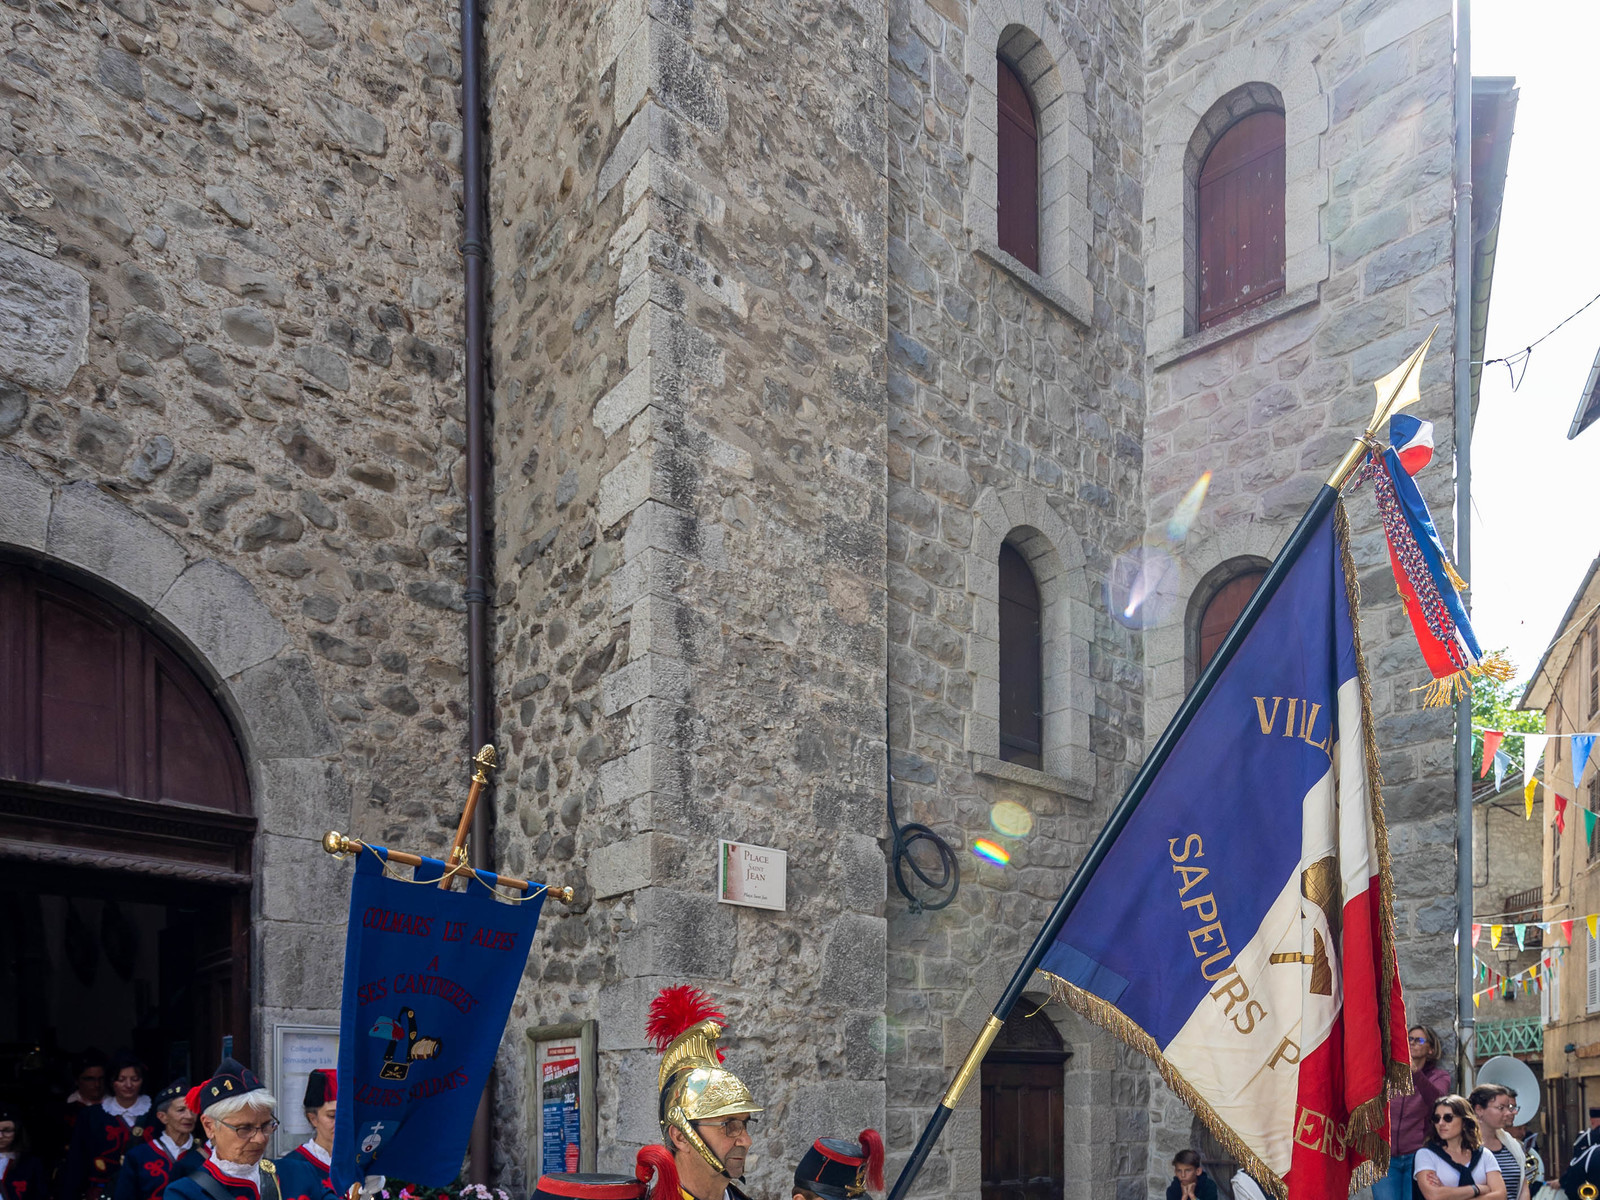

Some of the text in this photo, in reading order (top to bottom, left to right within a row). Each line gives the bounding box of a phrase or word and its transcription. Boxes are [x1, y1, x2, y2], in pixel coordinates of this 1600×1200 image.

[744, 850, 770, 864] PLACE
[745, 869, 766, 881] JEAN
[363, 907, 519, 951] COLMARS LES ALPES
[1167, 833, 1268, 1035] SAPEURS
[357, 977, 388, 1006] SES
[354, 1083, 407, 1107] LEURS
